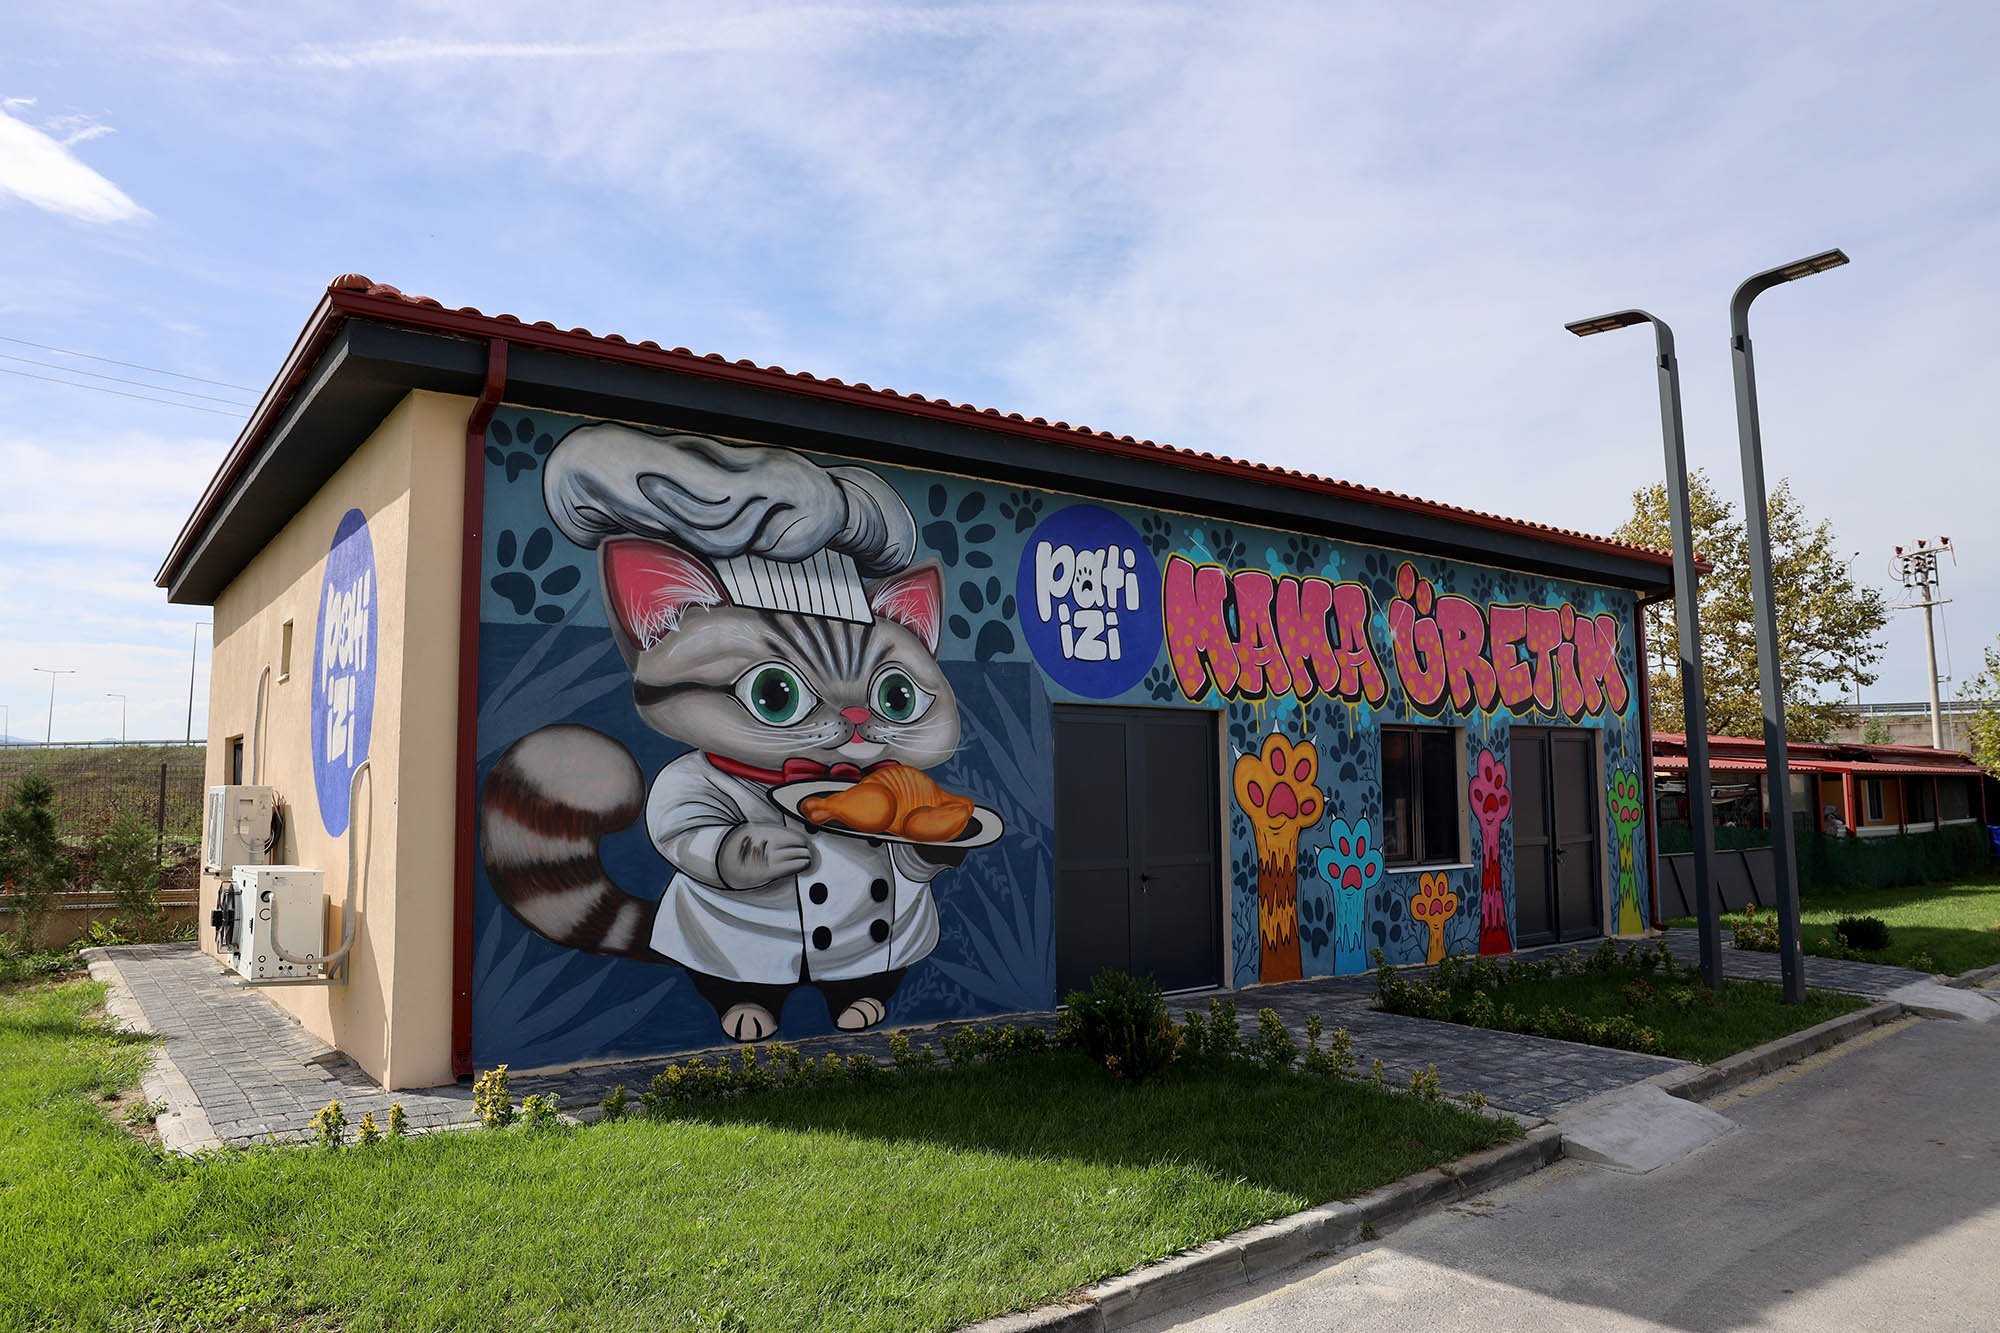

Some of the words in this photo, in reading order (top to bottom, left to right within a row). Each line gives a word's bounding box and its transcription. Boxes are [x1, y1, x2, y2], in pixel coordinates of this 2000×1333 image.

[1036, 541, 1139, 622] pati
[322, 569, 370, 693] pati
[1058, 603, 1121, 660] izi
[1164, 555, 1387, 706] MAMA
[327, 675, 355, 768] izi
